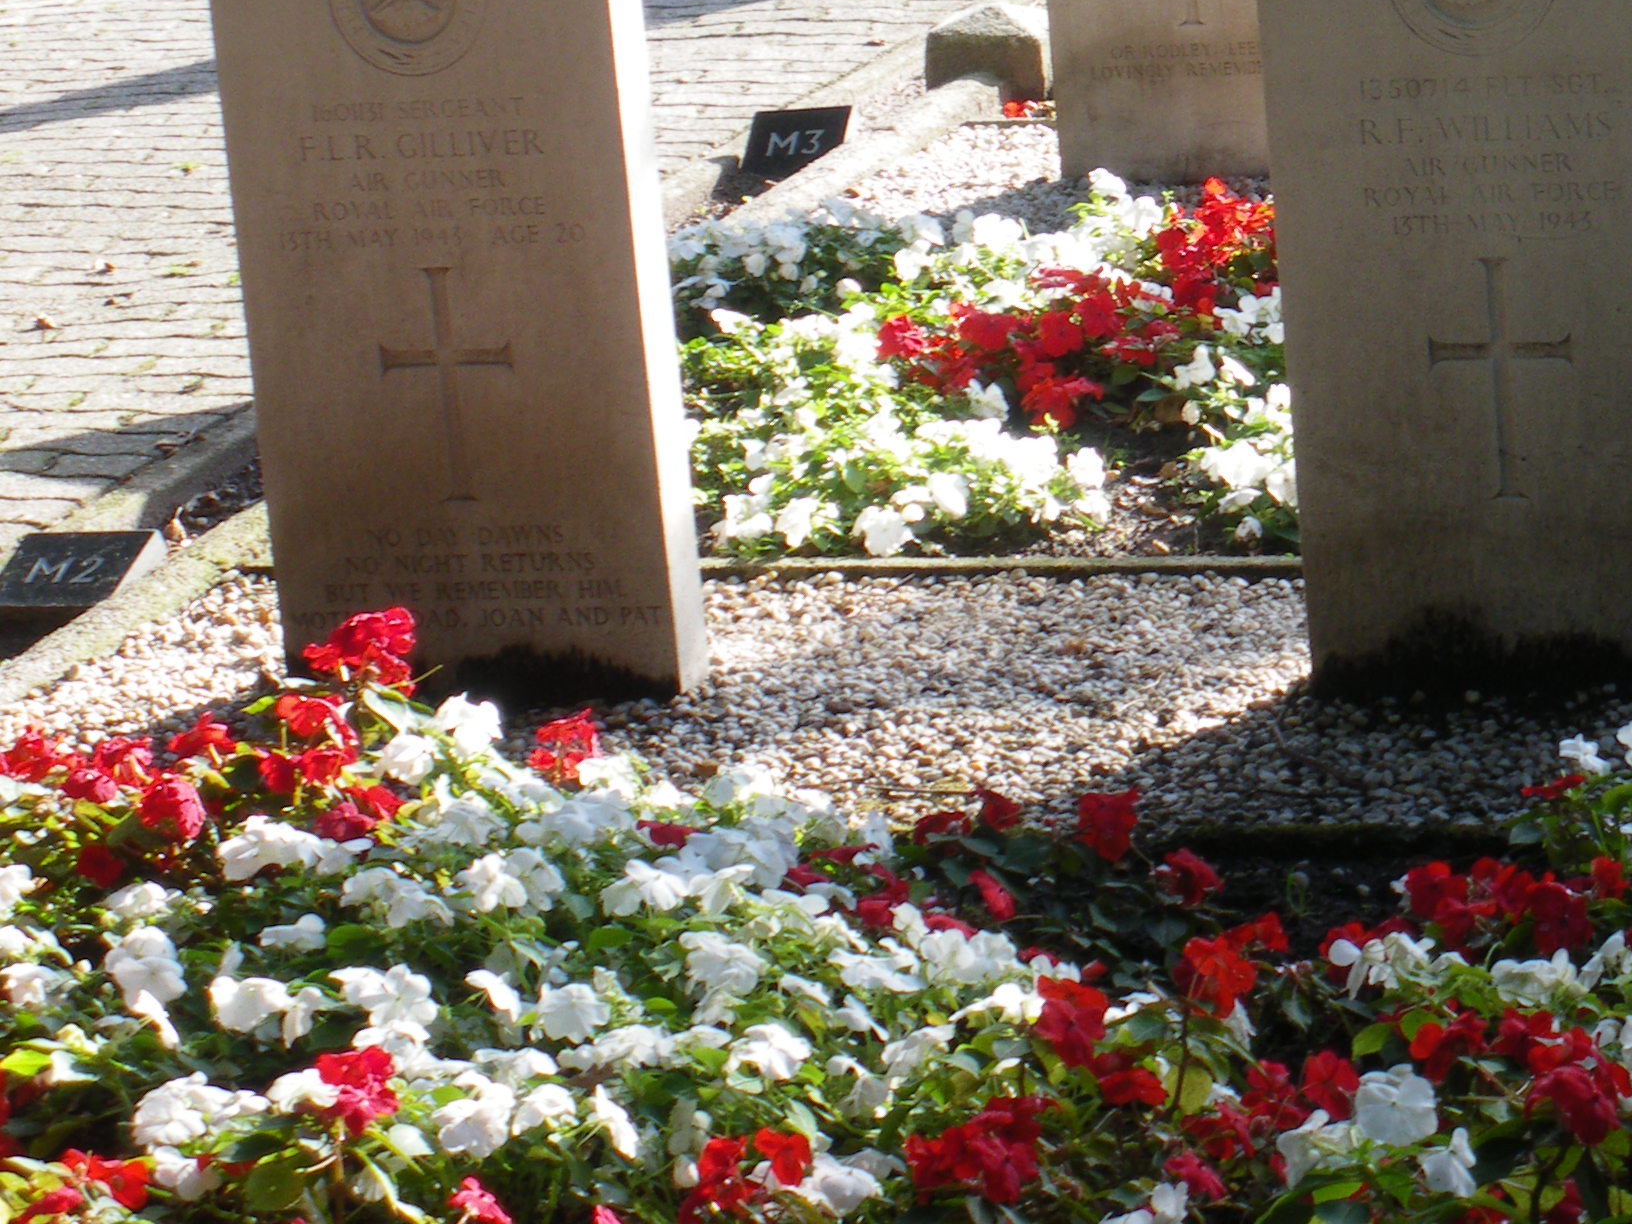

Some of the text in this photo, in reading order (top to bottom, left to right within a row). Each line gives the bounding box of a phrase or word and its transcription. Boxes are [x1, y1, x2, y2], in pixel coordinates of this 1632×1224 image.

[398, 95, 525, 122] SERGEANT
[1436, 109, 1614, 144] WILLIAMS
[298, 126, 546, 163] F.L.R. GILLIVER
[765, 128, 825, 157] M3
[1403, 151, 1574, 178] AIR GUNNER
[350, 167, 509, 193] AIR GUNNER
[1363, 179, 1618, 208] ROYAL AIR FORCE
[311, 195, 547, 223] ROYAL AIR FORCE
[1392, 208, 1594, 237] 13TH MAY 1943
[277, 222, 587, 252] 13TH MAY 1943 AGE 20
[366, 522, 565, 550] NO DAY DAWNS
[24, 554, 106, 585] M2
[344, 549, 597, 578] NO NIGHT RETURNS
[324, 582, 370, 605] BUT
[386, 580, 425, 604] WE
[434, 578, 563, 603] REMEMBER
[478, 606, 547, 629] JOAN
[559, 604, 611, 627] AND
[619, 603, 664, 627] PAT
